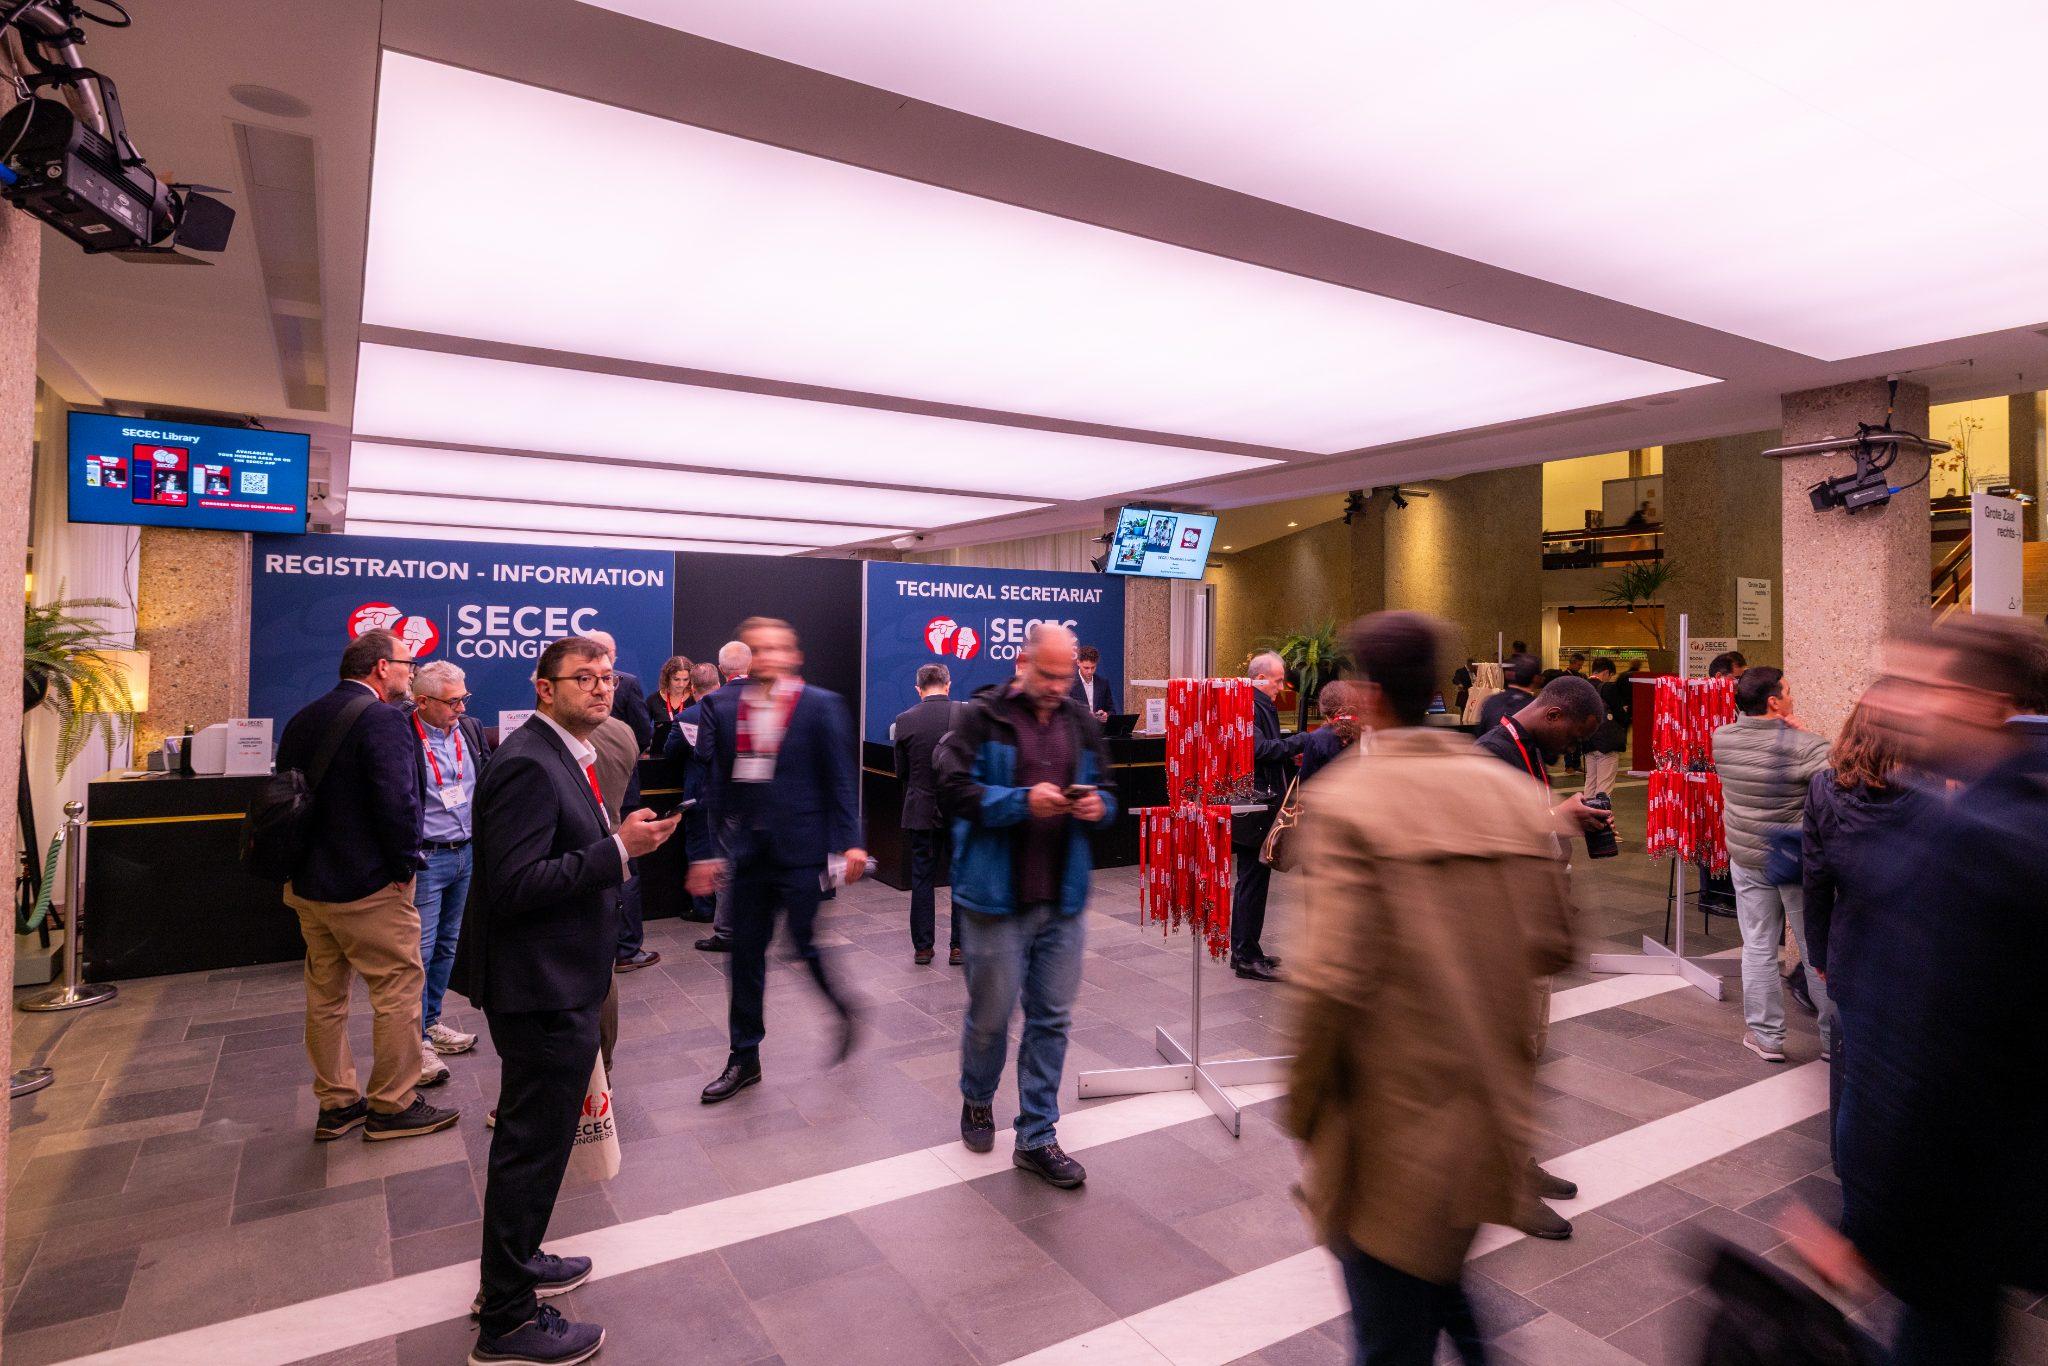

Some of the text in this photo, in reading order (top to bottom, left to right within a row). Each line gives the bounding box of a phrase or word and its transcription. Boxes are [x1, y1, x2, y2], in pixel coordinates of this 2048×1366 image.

[122, 428, 200, 444] SECEC Library
[1984, 506, 2016, 522] Grote Zaal
[1996, 526, 2016, 539] rechts
[265, 554, 469, 581] REGISTRATION
[493, 563, 664, 588] INFORMATION
[896, 580, 1103, 603] TECHNICAL SECRETARIAT
[456, 604, 599, 637] SECEC
[456, 639, 554, 659] CONGR
[572, 1129, 614, 1146] ONGRESS
[575, 1117, 612, 1138] ECEC
